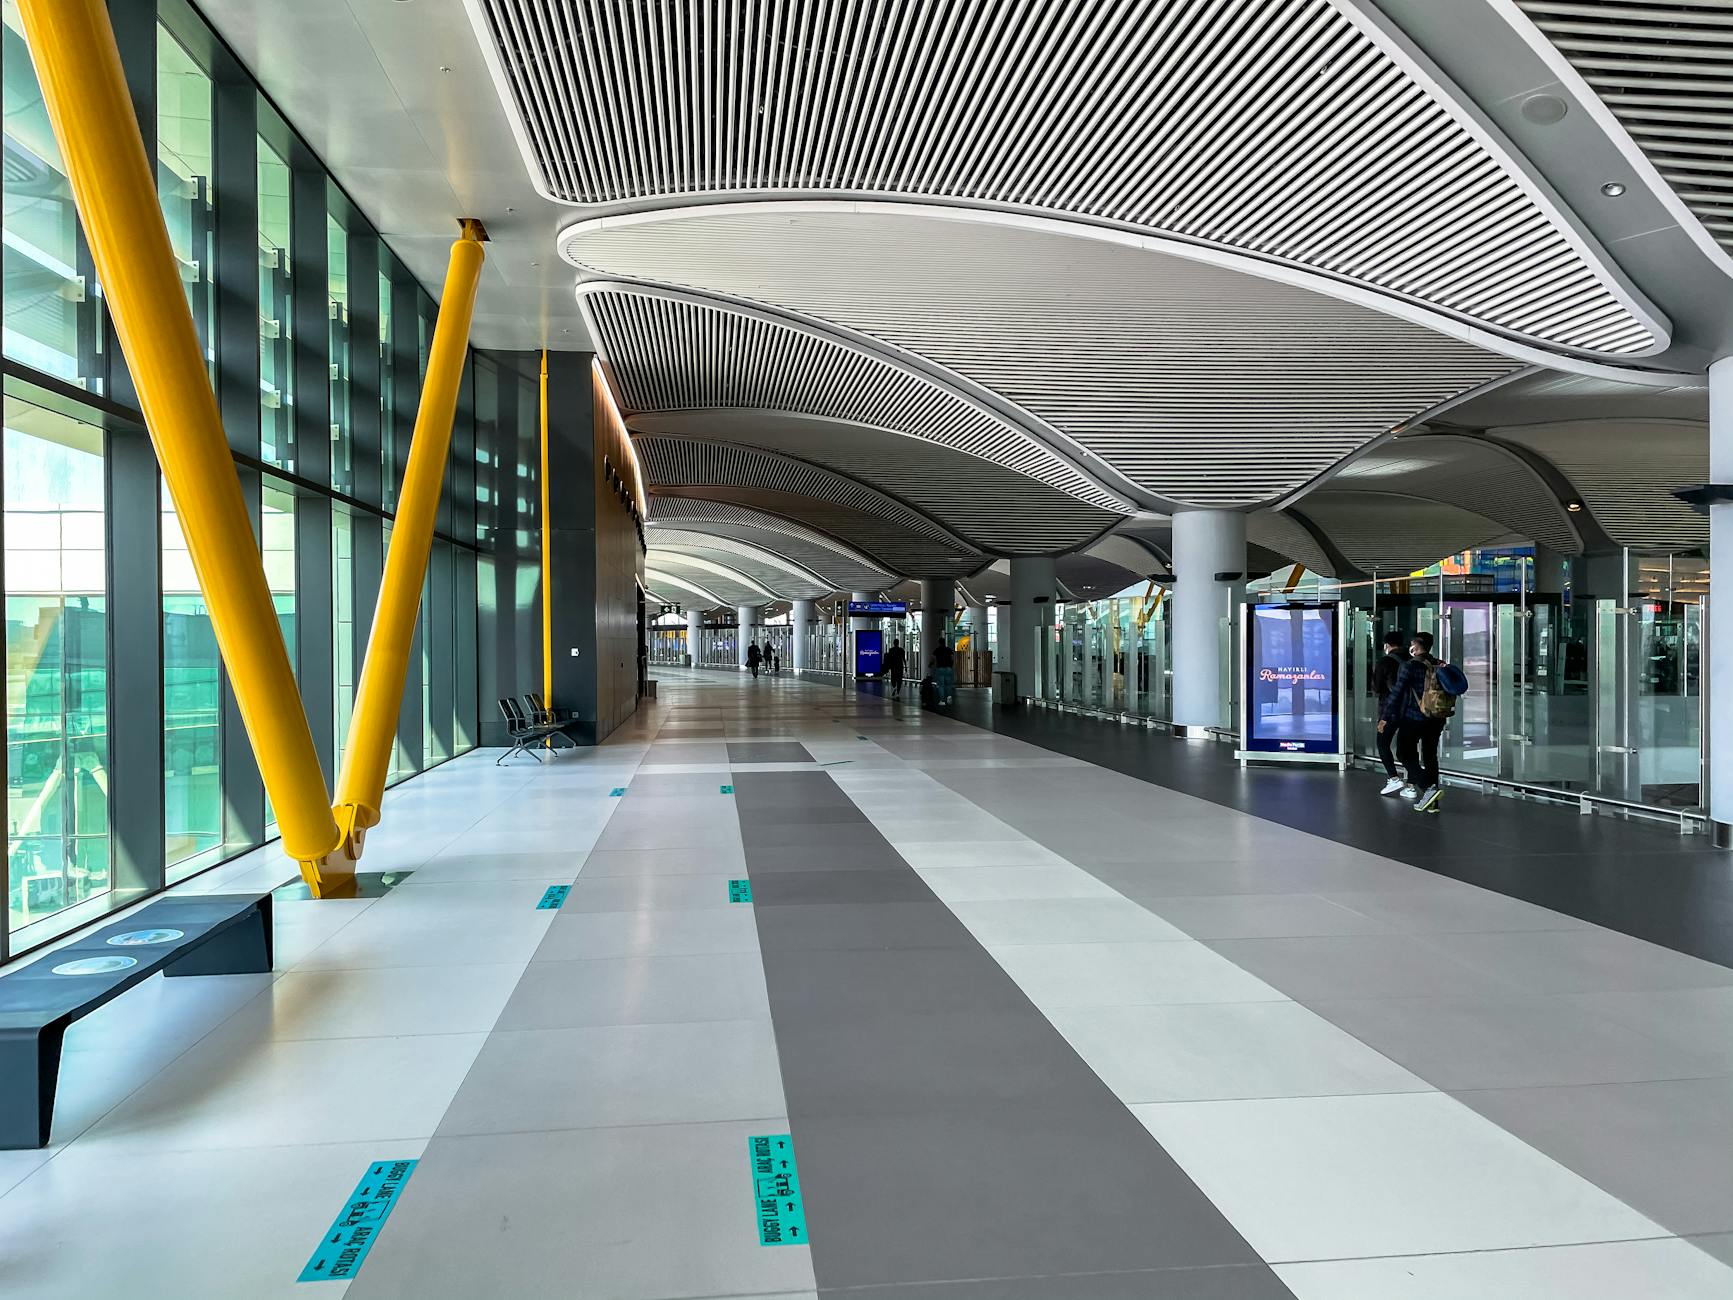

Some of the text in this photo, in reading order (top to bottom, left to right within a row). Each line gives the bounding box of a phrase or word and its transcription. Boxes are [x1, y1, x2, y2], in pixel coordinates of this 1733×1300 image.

[1260, 669, 1325, 684] Ramazanlar
[754, 1137, 775, 1173] ARAÇ ROTASI
[374, 1162, 410, 1199] BUGGY LANE
[761, 1199, 782, 1242] BUGGY LANE
[328, 1226, 373, 1277] ARAÇ ROTASI
